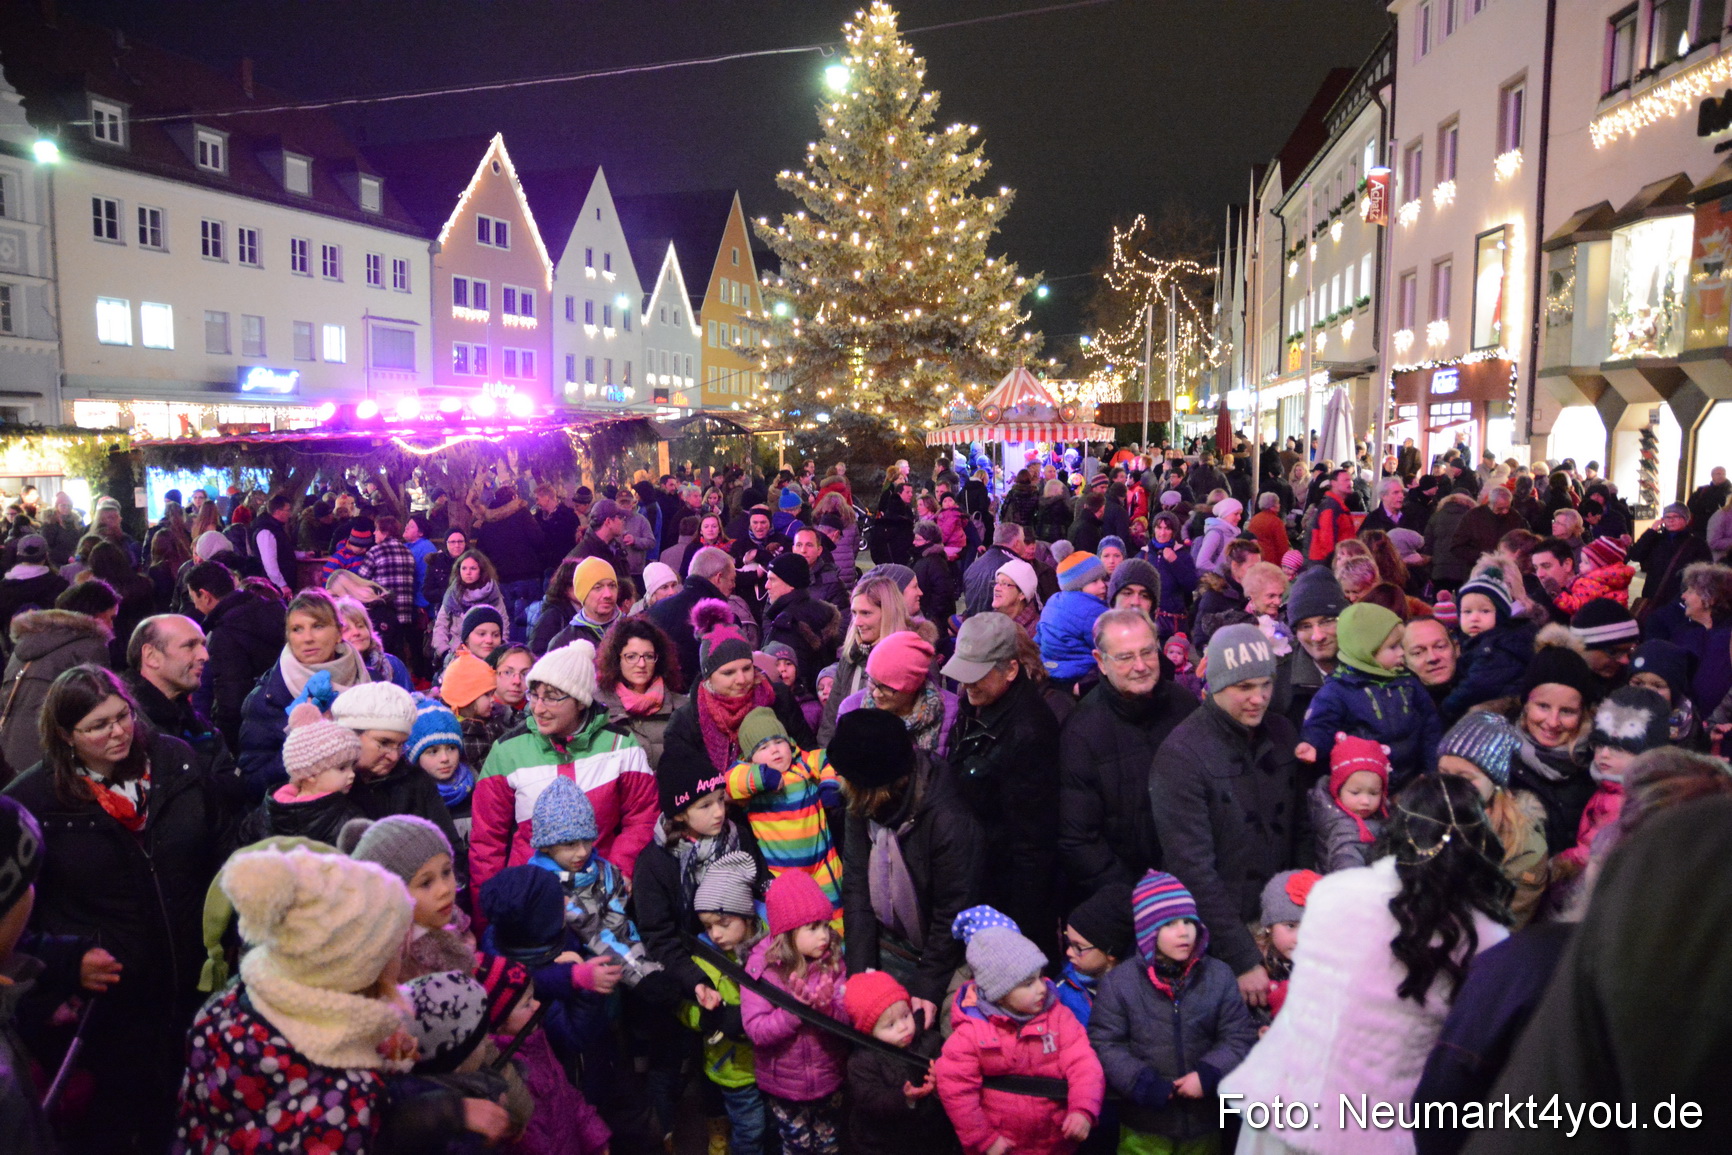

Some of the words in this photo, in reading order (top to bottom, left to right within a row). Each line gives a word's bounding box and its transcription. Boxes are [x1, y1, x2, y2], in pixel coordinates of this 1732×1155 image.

[1370, 179, 1385, 220] Achatz
[1224, 641, 1270, 670] RAW
[675, 791, 690, 806] Los
